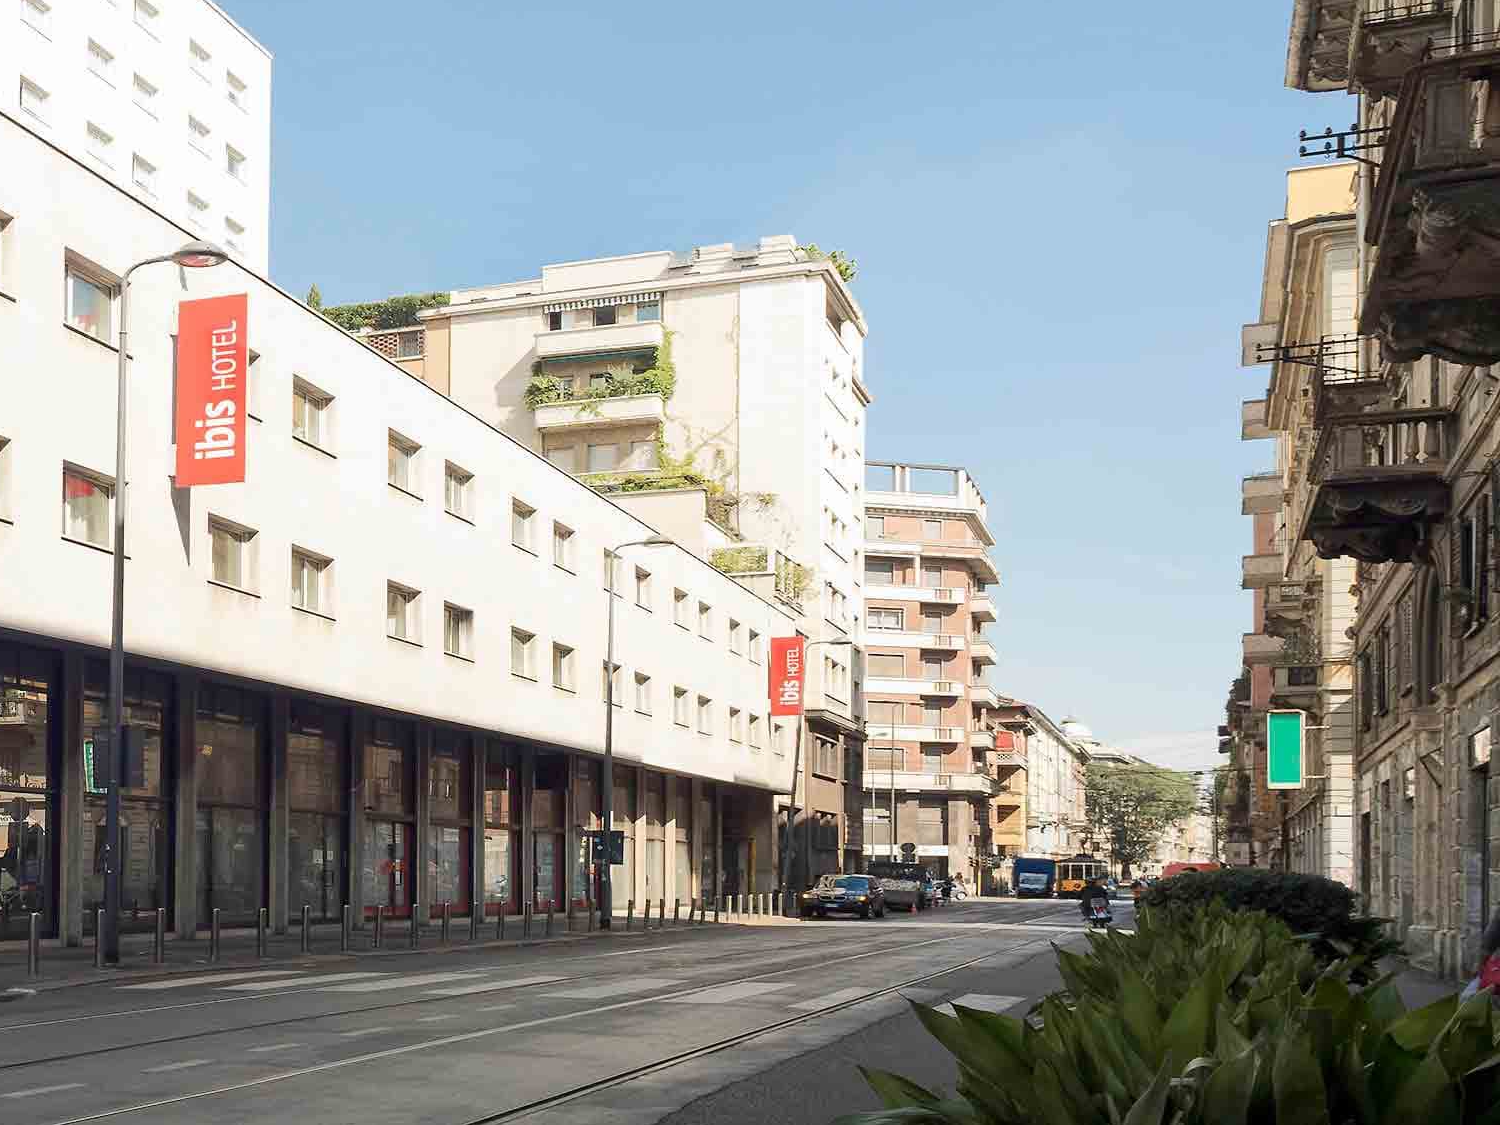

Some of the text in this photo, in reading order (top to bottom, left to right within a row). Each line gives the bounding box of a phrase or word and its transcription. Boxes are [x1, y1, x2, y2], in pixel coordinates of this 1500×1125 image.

[194, 319, 237, 460] ibis HOTEL
[779, 646, 799, 706] ibis HOTEL
